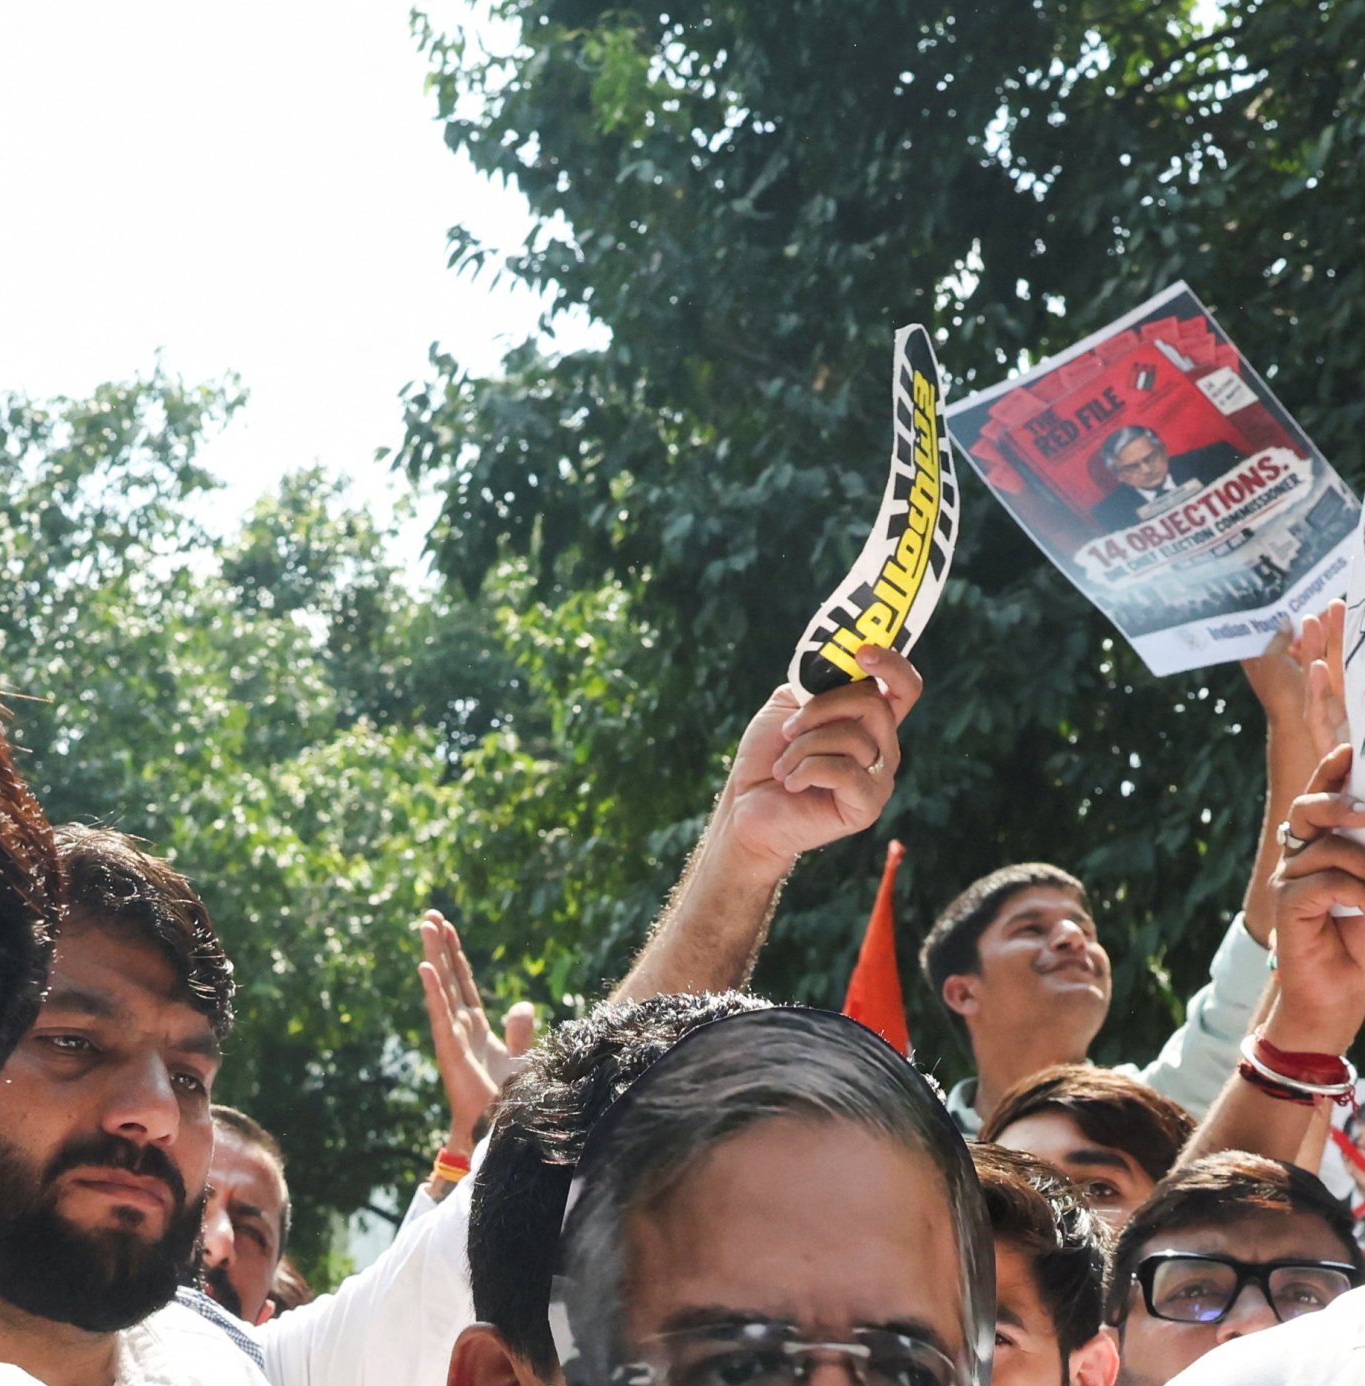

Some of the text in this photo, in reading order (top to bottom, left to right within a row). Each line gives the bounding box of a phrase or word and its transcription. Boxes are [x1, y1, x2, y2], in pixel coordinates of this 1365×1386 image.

[1024, 408, 1060, 434] THE
[1034, 419, 1080, 455] RED
[1075, 387, 1125, 430] FILE
[1087, 539, 1127, 568] 14
[1126, 455, 1290, 552] OBJECTIONS.
[1157, 527, 1215, 558] ELECTION
[1207, 622, 1252, 641] Indian
[1289, 556, 1348, 614] Congress
